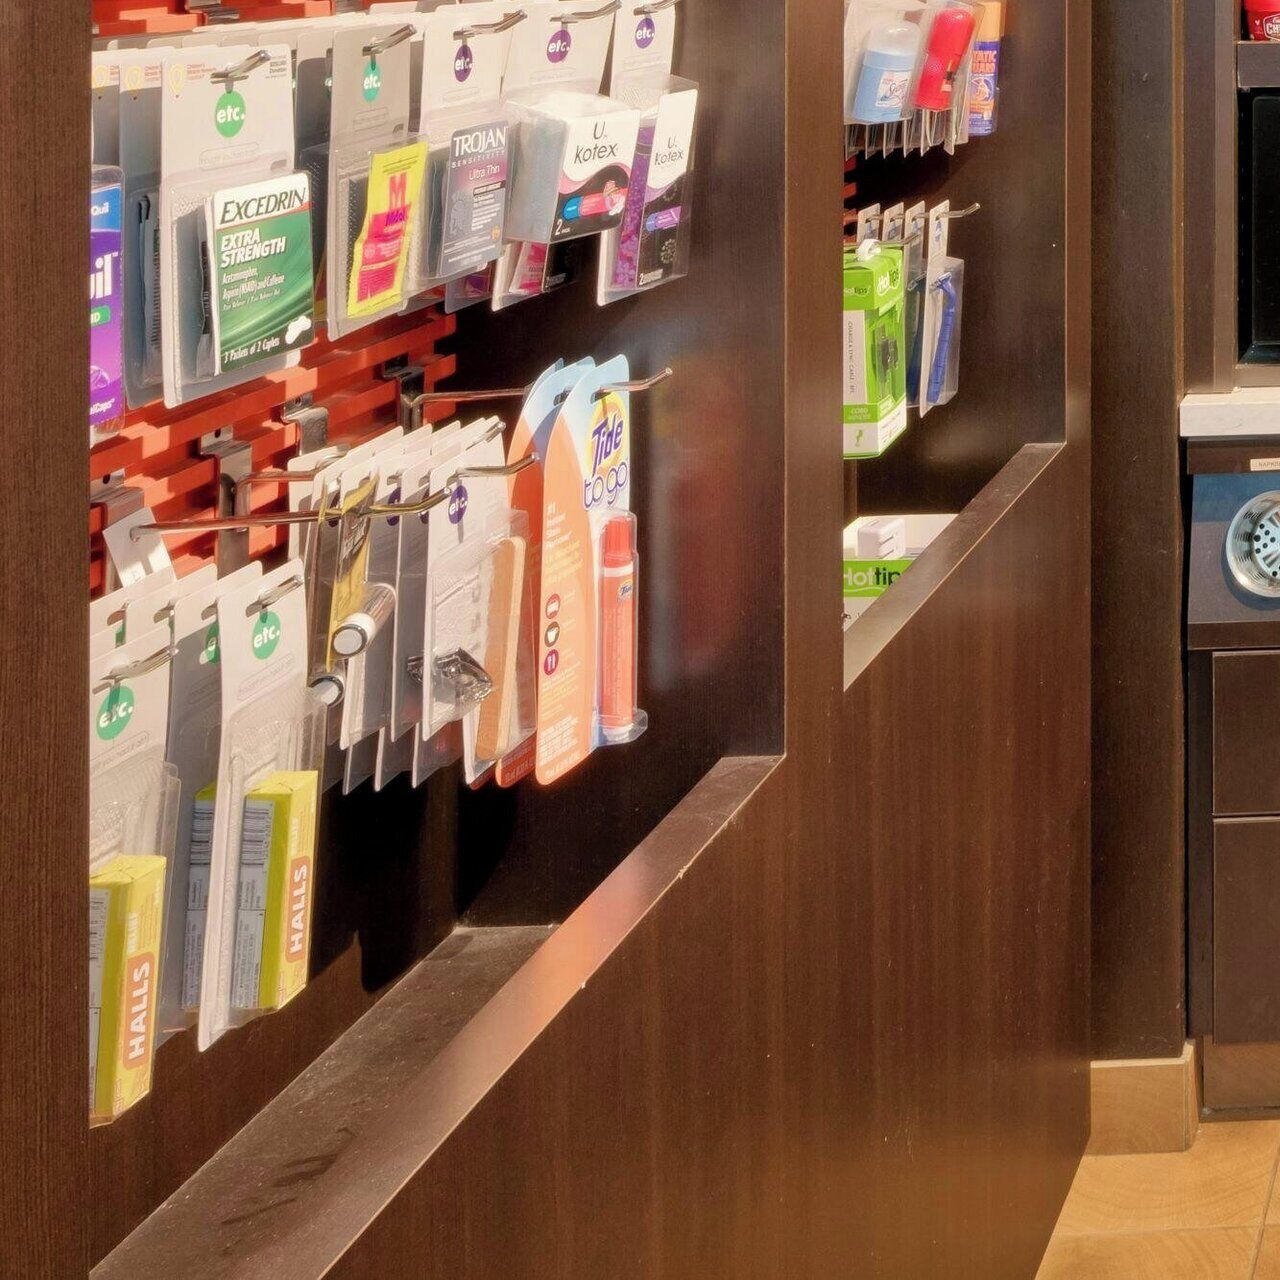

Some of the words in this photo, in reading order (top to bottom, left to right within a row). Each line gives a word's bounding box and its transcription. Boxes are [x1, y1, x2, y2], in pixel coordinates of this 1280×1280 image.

[636, 27, 654, 40] etc.
[549, 39, 570, 54] etc.
[455, 55, 473, 72] etc.
[364, 72, 381, 90] etc.
[217, 104, 245, 124] etc.
[453, 127, 507, 158] TROJAN
[575, 141, 618, 165] kotex
[655, 148, 684, 166] kotex
[468, 168, 486, 182] Ultra
[220, 187, 306, 225] EXCEDRIN
[221, 227, 261, 252] EXTRA
[221, 236, 287, 269] STRENGTH
[592, 413, 624, 477] Tide
[252, 627, 281, 647] etc.
[97, 701, 134, 727] etc.
[289, 863, 308, 956] HALLS
[129, 960, 151, 1060] HALLS
